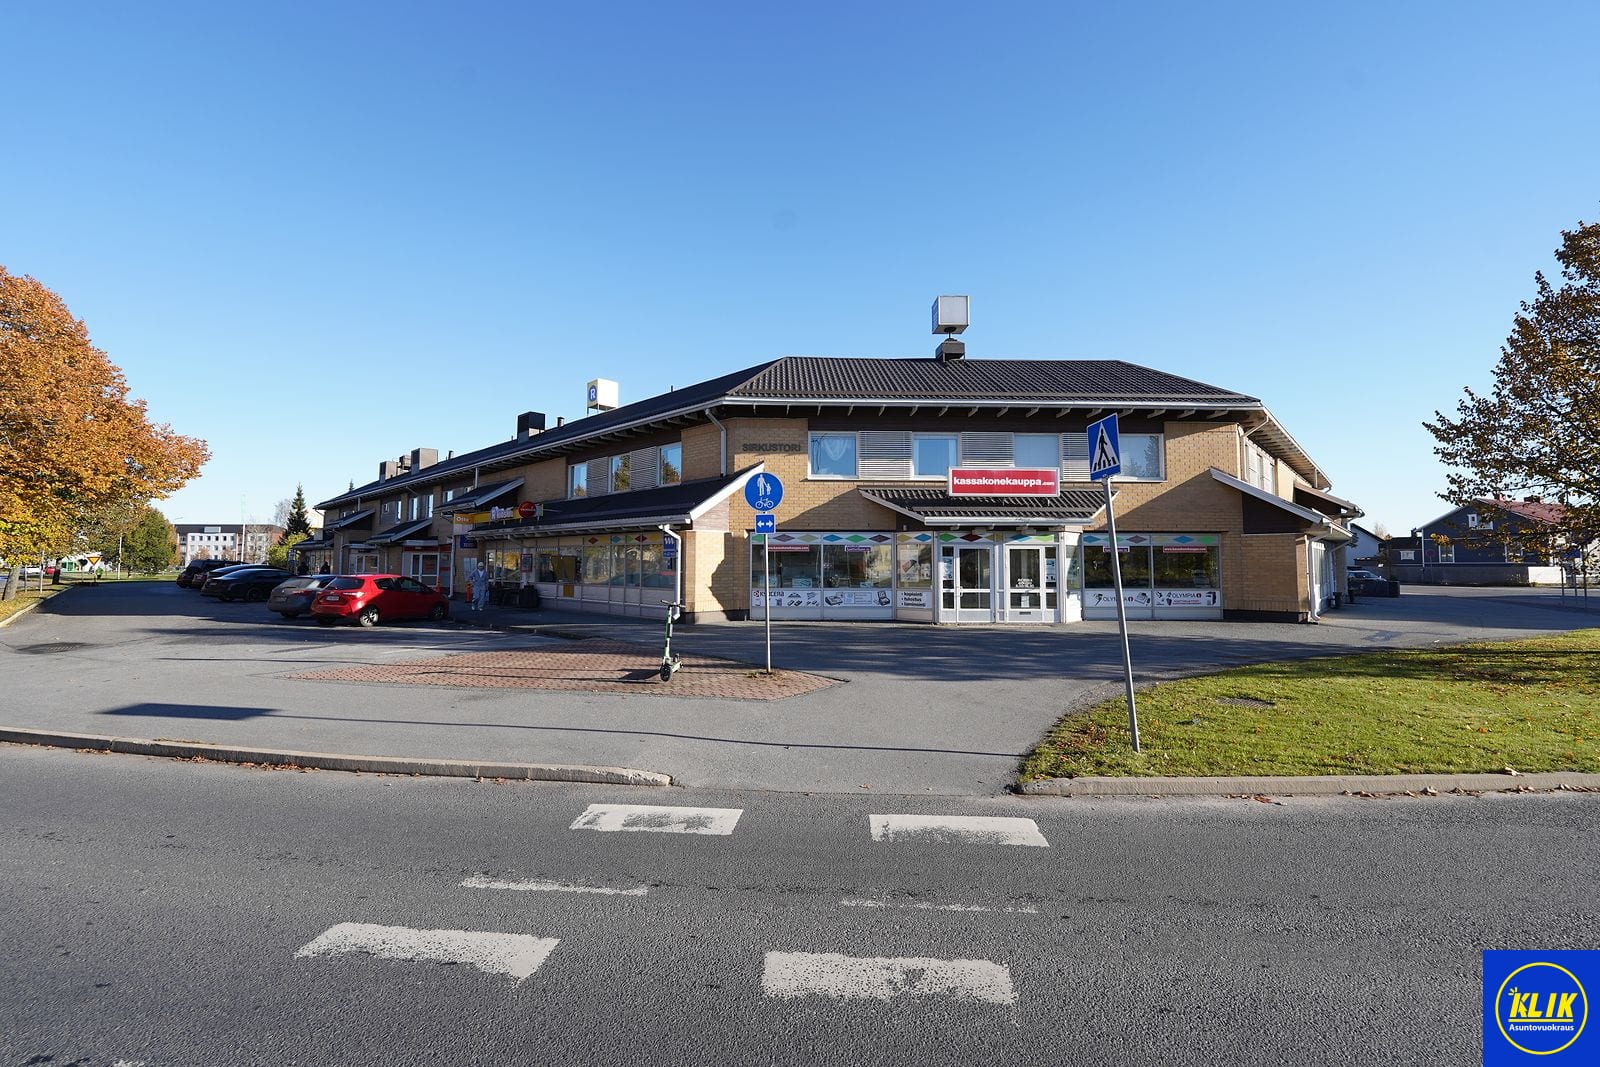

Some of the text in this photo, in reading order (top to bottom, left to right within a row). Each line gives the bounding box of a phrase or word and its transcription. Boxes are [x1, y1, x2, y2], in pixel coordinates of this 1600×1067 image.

[590, 388, 596, 400] R
[742, 443, 801, 451] SIRKUSTORI
[953, 477, 1055, 487] kassakonekauppa.com
